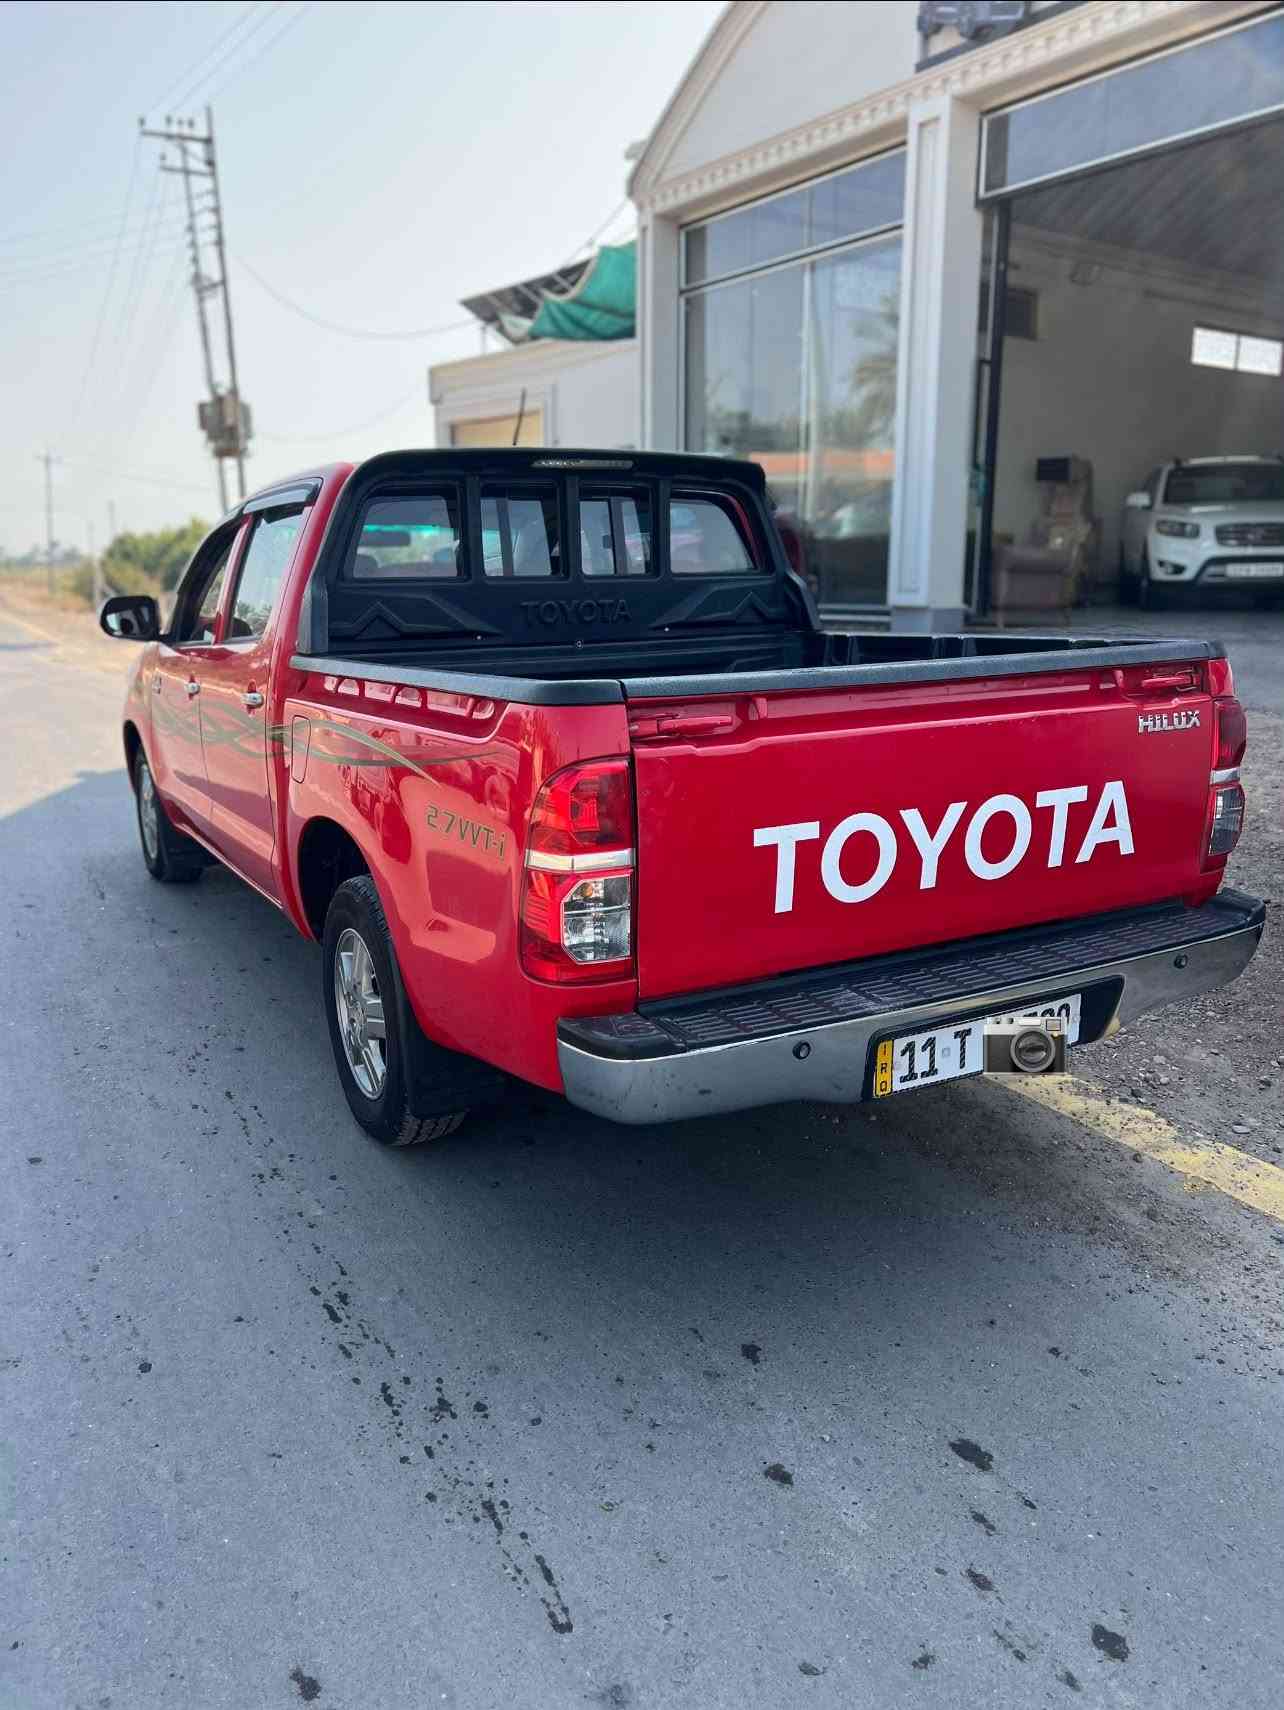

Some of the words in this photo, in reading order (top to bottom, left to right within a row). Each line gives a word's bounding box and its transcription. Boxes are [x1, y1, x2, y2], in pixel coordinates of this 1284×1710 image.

[520, 599, 632, 626] TOYOTA
[1137, 710, 1201, 734] HILUX
[753, 780, 1135, 914] TOYOTA
[899, 1036, 939, 1083] 11
[953, 1027, 972, 1069] T
